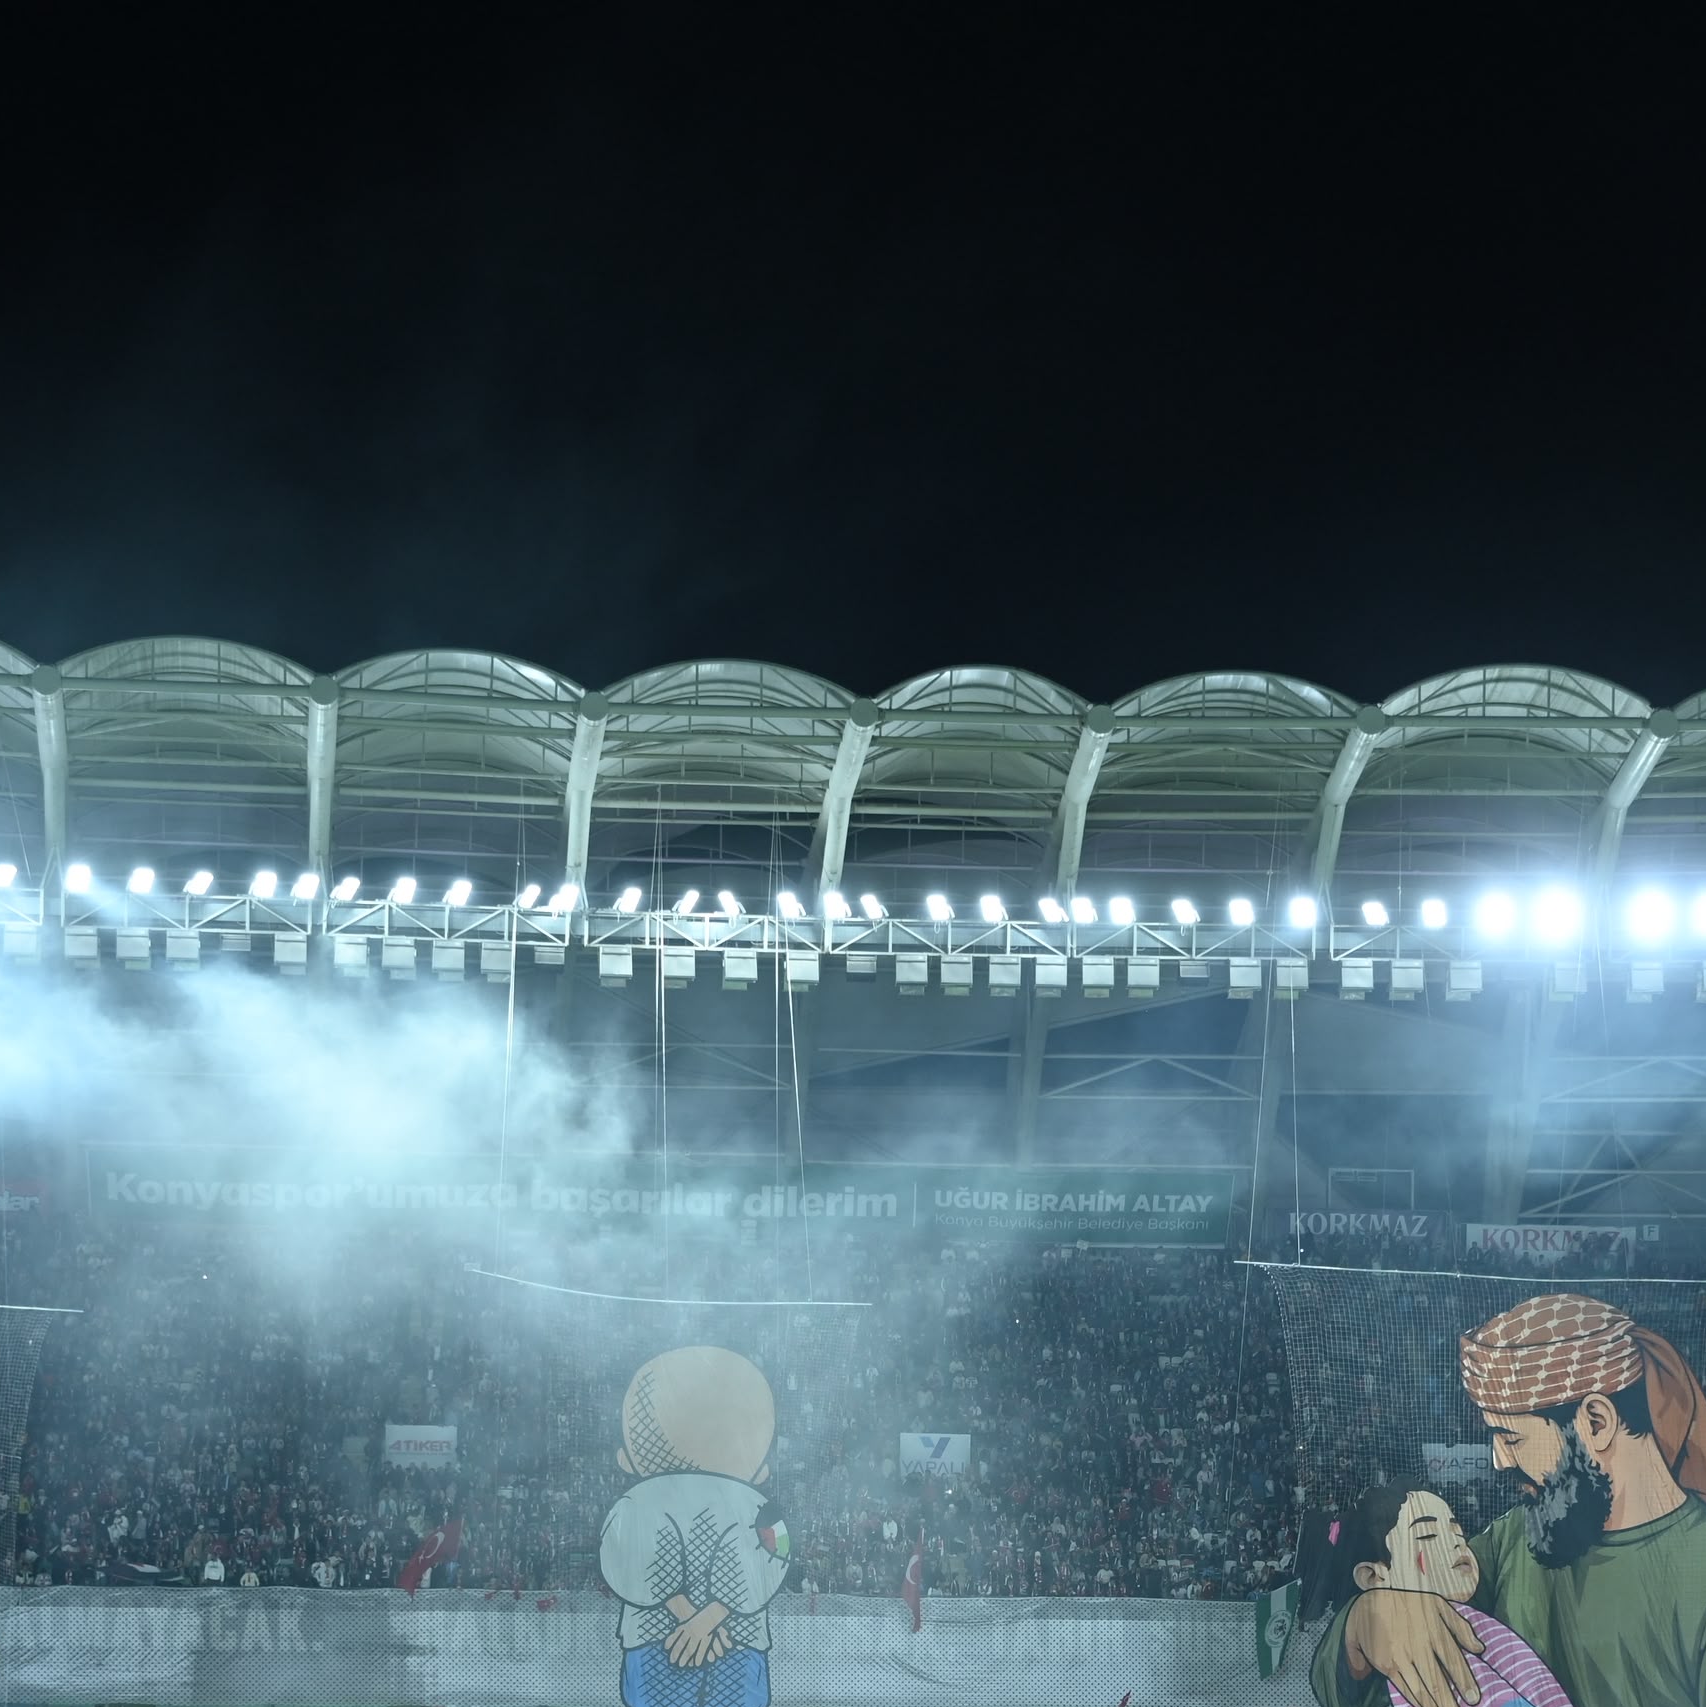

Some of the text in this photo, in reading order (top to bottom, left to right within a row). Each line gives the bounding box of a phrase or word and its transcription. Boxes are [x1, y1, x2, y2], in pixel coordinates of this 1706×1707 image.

[742, 1184, 898, 1218] dilerim
[934, 1186, 1214, 1214] UĞUR İBRAHİM ALTAY
[935, 1212, 1210, 1232] Konya Büyükşehir Belediye Başkanı
[1288, 1211, 1429, 1238] KORKMAZ
